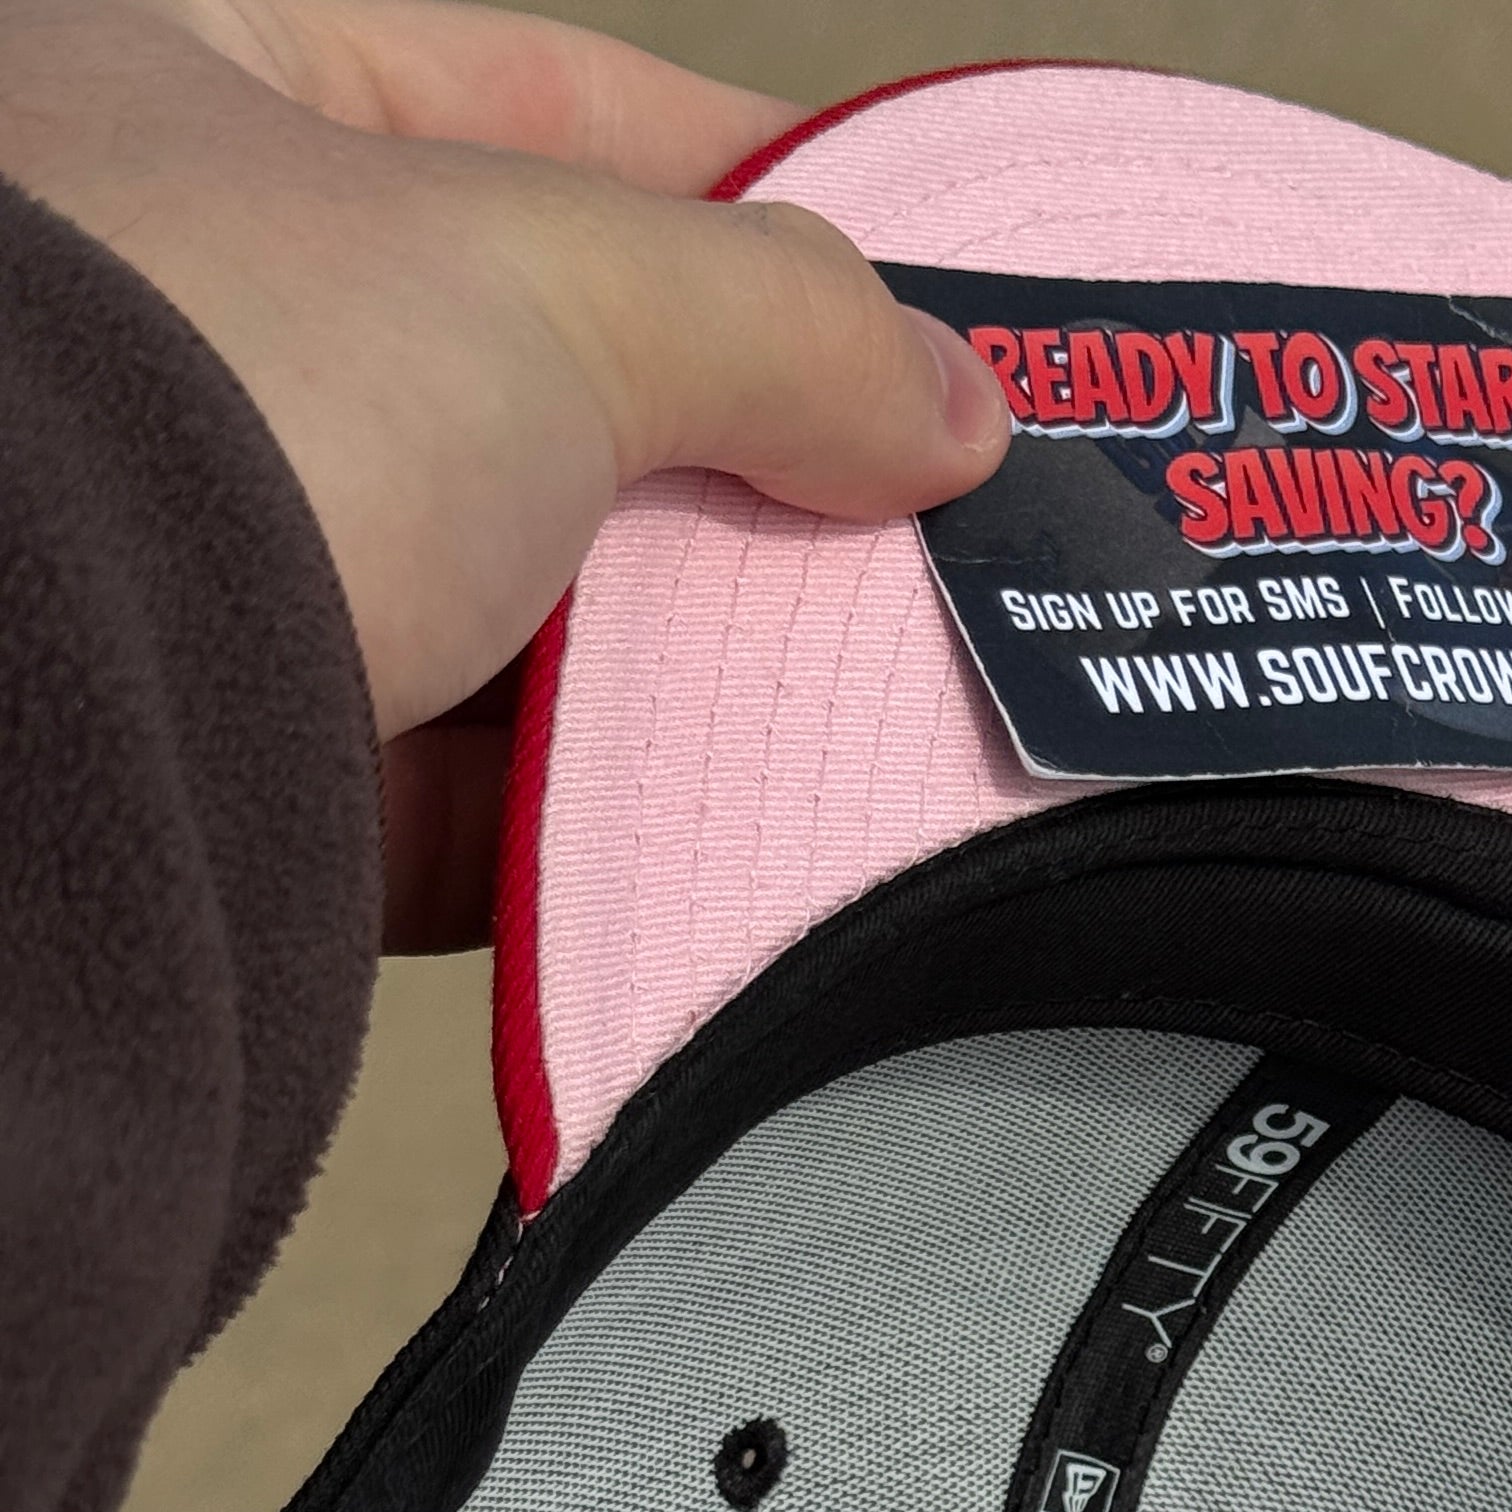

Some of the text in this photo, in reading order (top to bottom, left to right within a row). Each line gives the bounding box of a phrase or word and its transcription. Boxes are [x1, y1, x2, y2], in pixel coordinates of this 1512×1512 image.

[967, 325, 1236, 440] READY
[1233, 329, 1357, 437] TO
[1164, 447, 1507, 567] SAVING?
[1000, 588, 1103, 632] SIGN
[1104, 590, 1161, 629] UP
[1168, 585, 1255, 628] FOR
[1256, 575, 1351, 623] SMS
